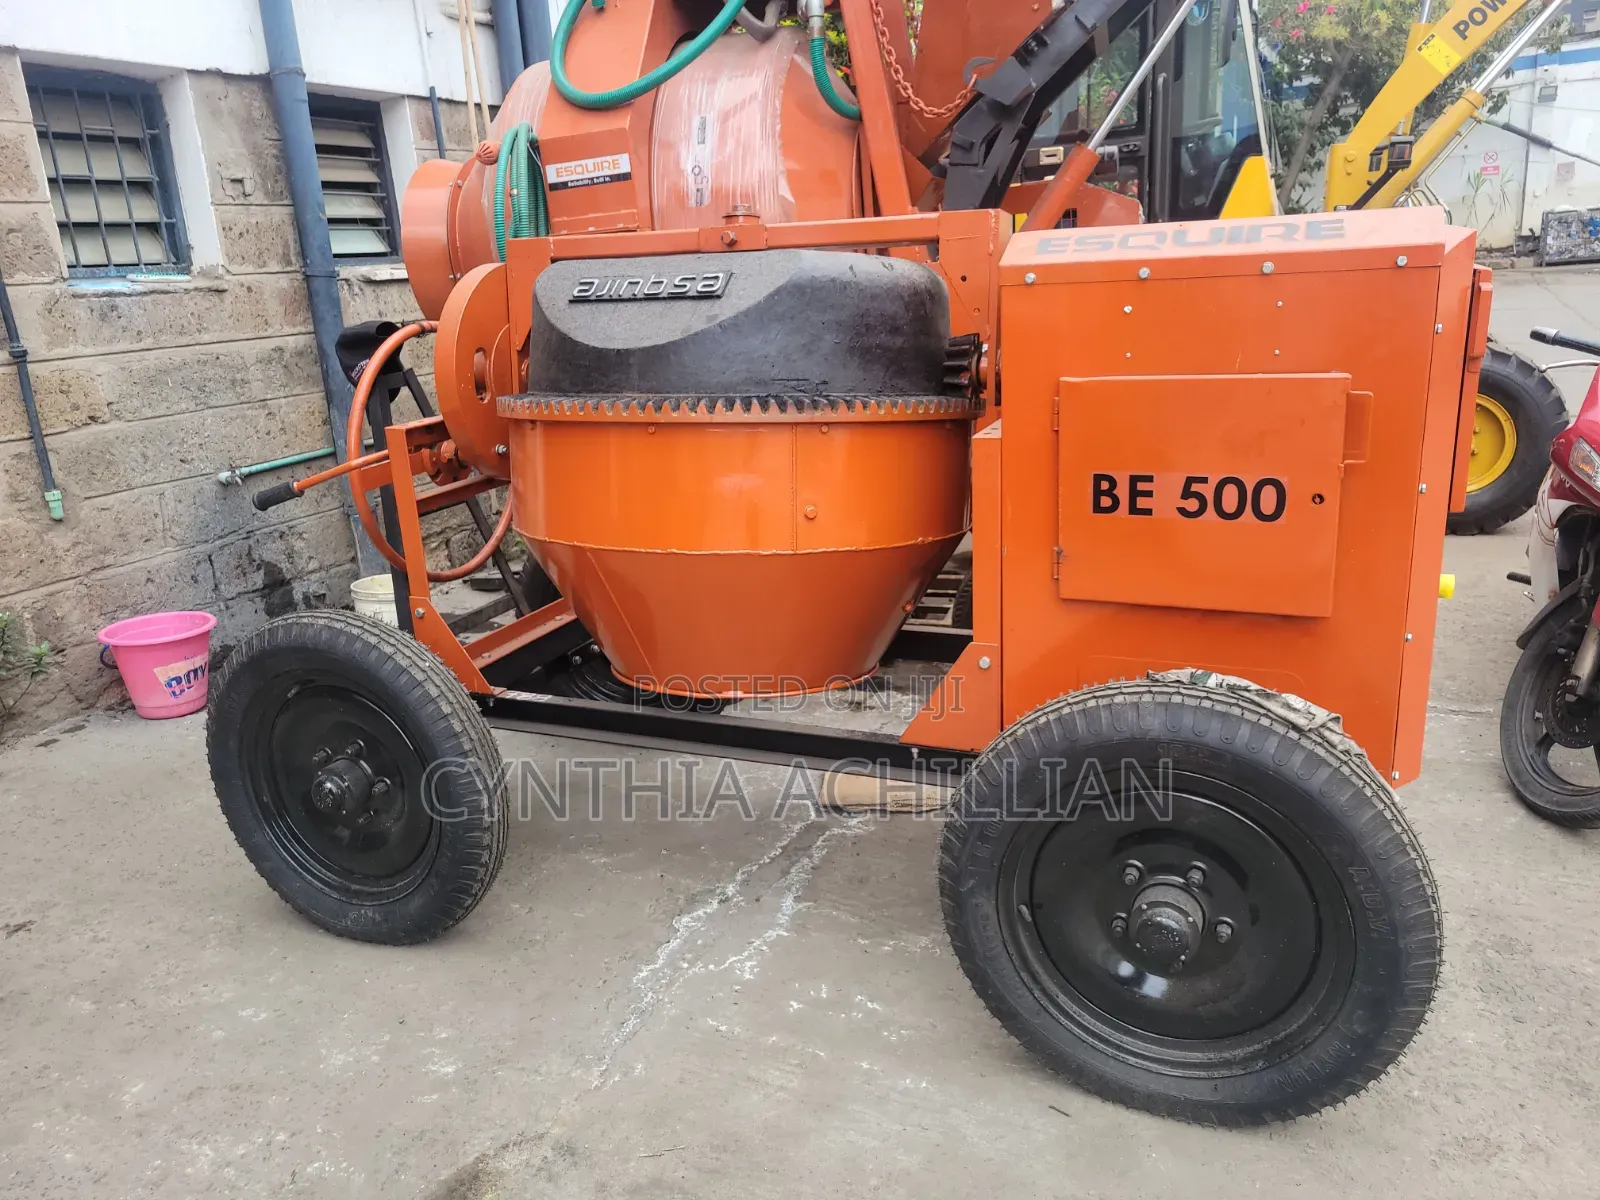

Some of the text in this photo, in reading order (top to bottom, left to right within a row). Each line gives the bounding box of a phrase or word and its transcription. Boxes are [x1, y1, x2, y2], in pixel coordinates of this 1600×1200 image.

[556, 159, 621, 178] ESQUIRE
[1034, 218, 1345, 256] ESQUIRE
[1092, 473, 1287, 523] BE 500
